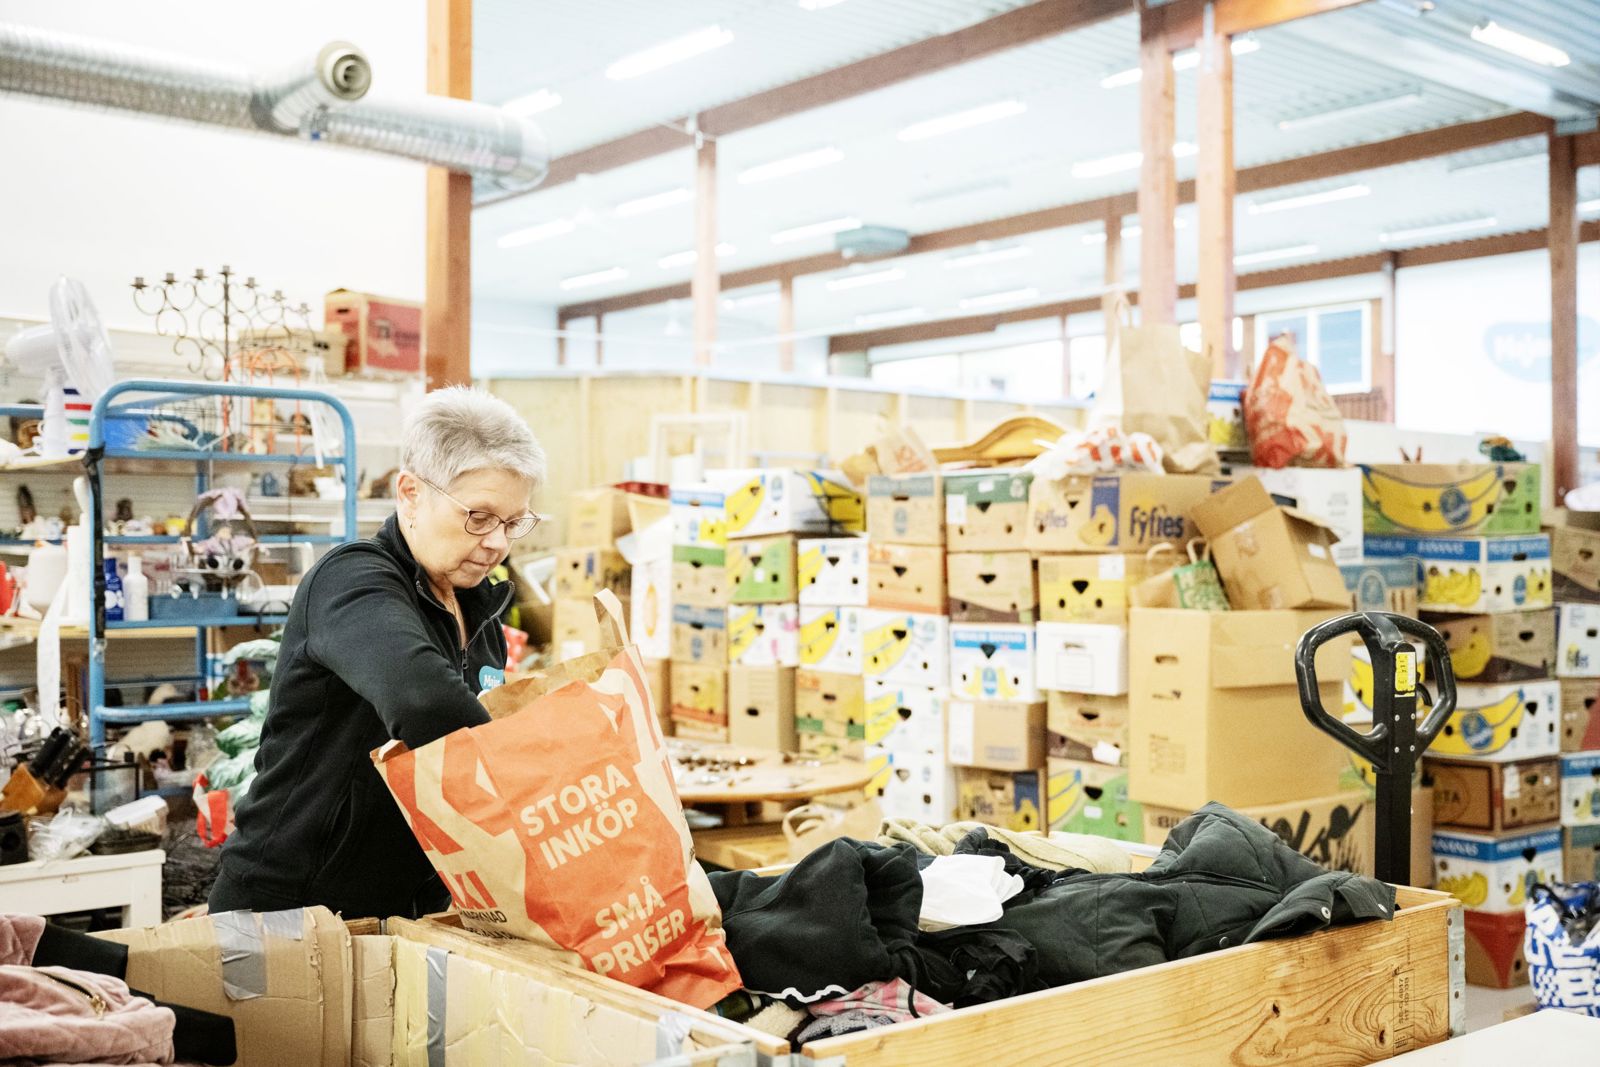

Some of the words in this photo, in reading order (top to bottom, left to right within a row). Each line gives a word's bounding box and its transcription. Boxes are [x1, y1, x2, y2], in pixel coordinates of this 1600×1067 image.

[519, 763, 632, 837] STORA
[539, 797, 638, 870] INKÖP
[591, 908, 687, 975] PRISER
[595, 875, 667, 939] SMÅ
